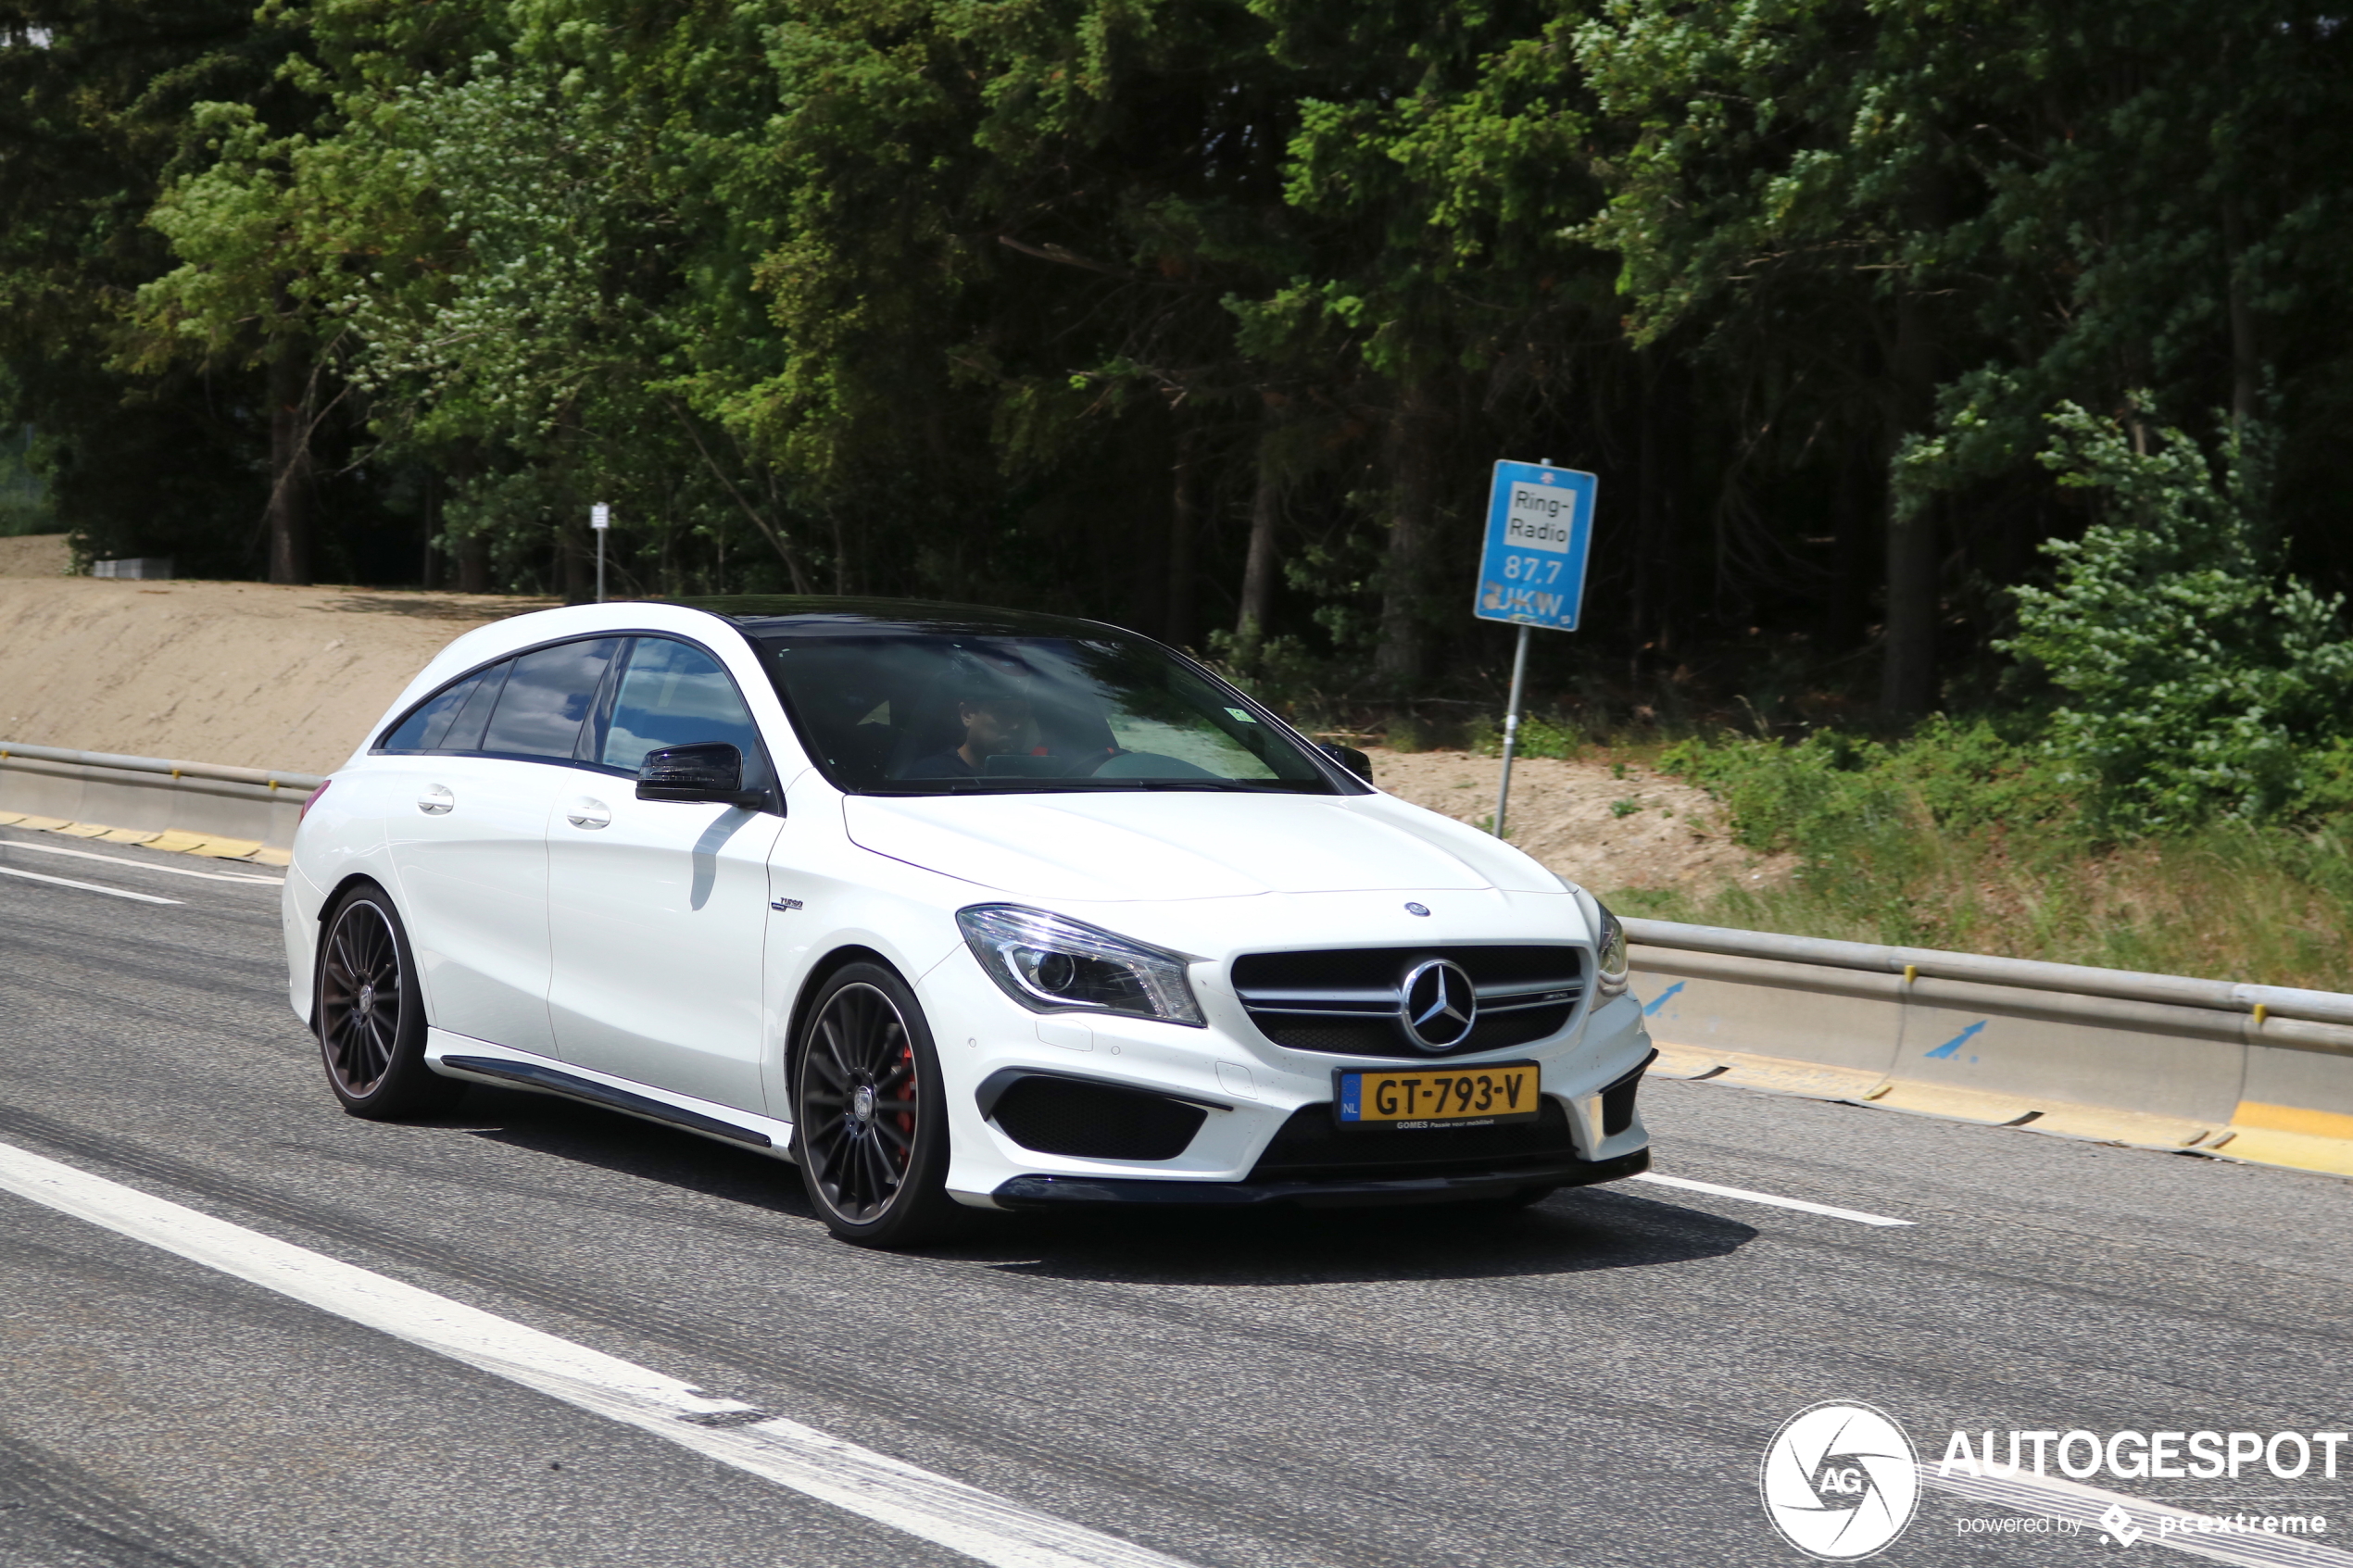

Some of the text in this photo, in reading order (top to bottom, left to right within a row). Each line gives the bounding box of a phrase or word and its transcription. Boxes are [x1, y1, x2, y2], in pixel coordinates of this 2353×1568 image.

[1515, 490, 1569, 518] Ring-
[1509, 518, 1568, 543] Radio
[1504, 555, 1563, 584] 87.7
[1376, 1073, 1524, 1115] GT-793-V
[1343, 1103, 1358, 1114] NL
[1397, 1121, 1428, 1129] GOMES
